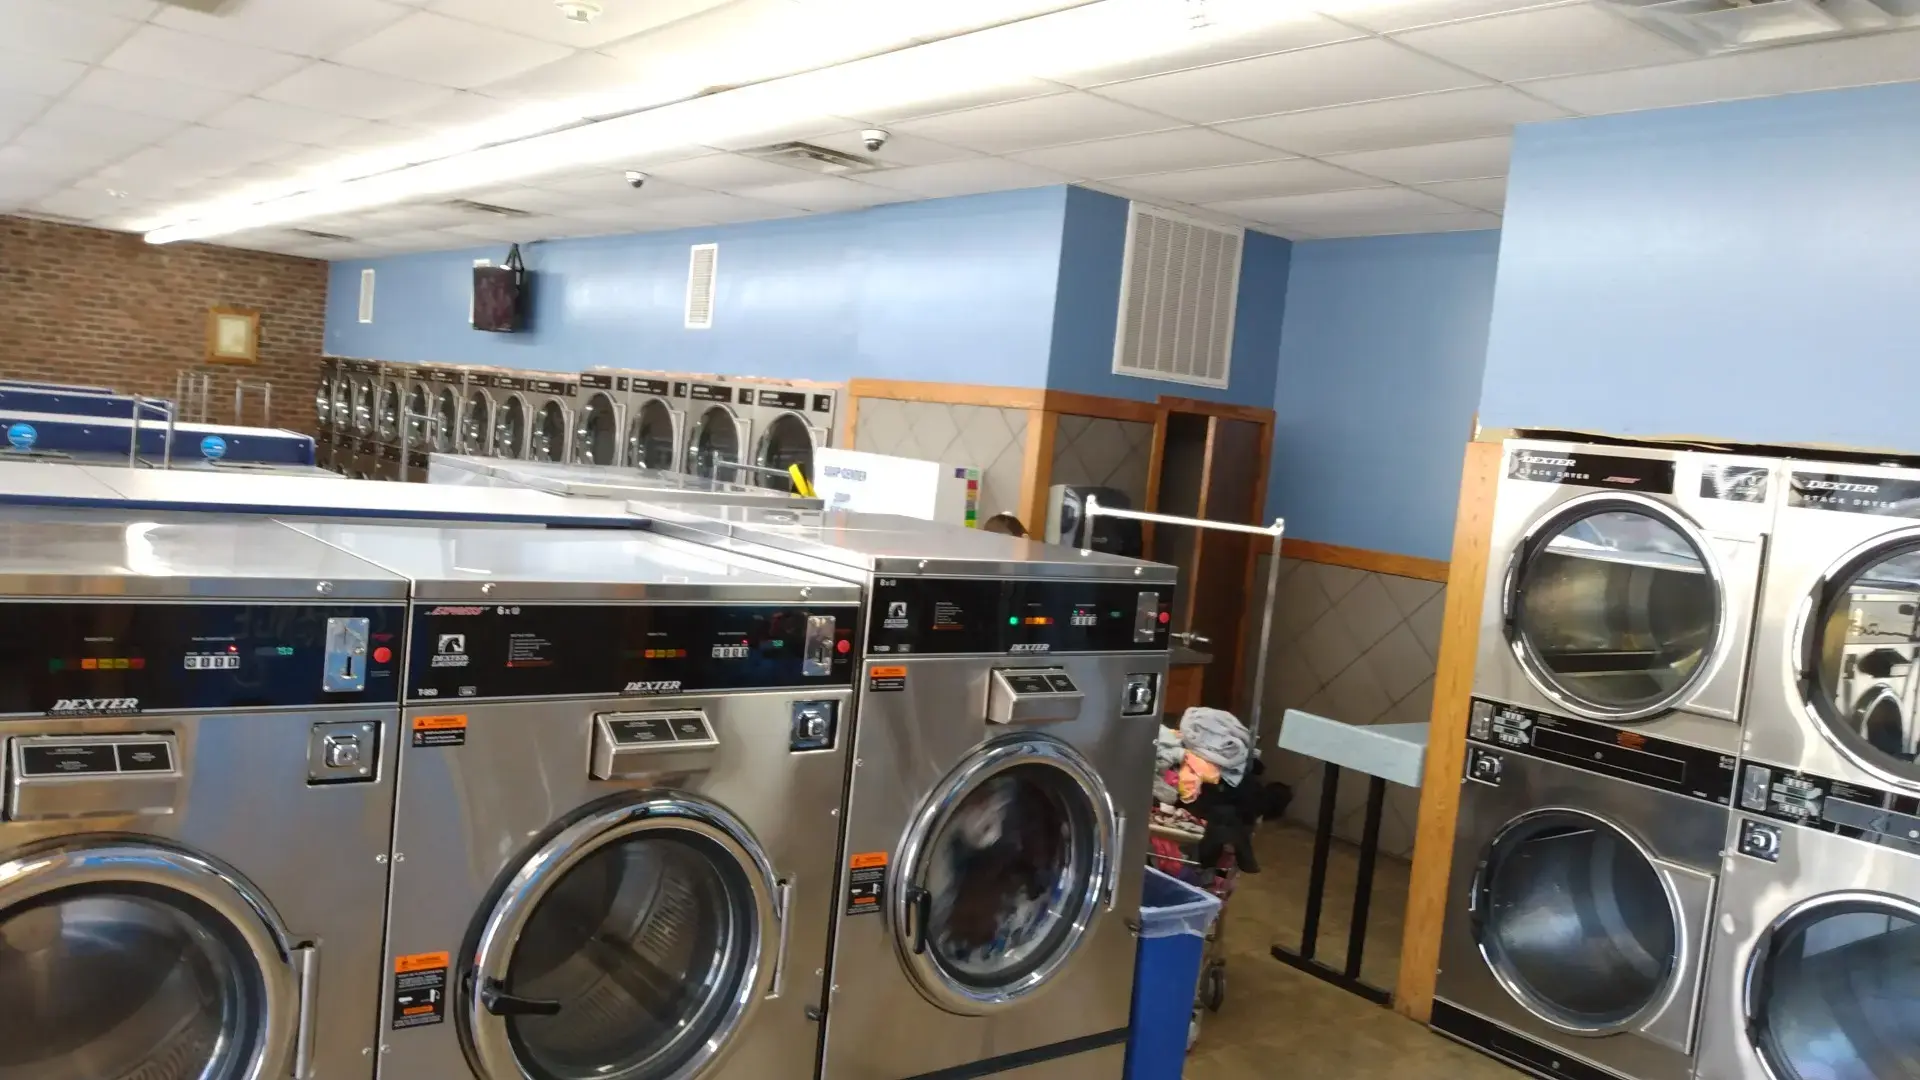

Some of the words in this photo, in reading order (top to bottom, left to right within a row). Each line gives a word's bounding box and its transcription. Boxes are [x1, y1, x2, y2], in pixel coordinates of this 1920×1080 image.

[1520, 456, 1577, 467] DEXTER
[1806, 480, 1879, 493] DEXTER
[1010, 643, 1050, 651] DEXTER
[624, 680, 681, 691] DEXTER
[51, 697, 139, 711] DEXTER
